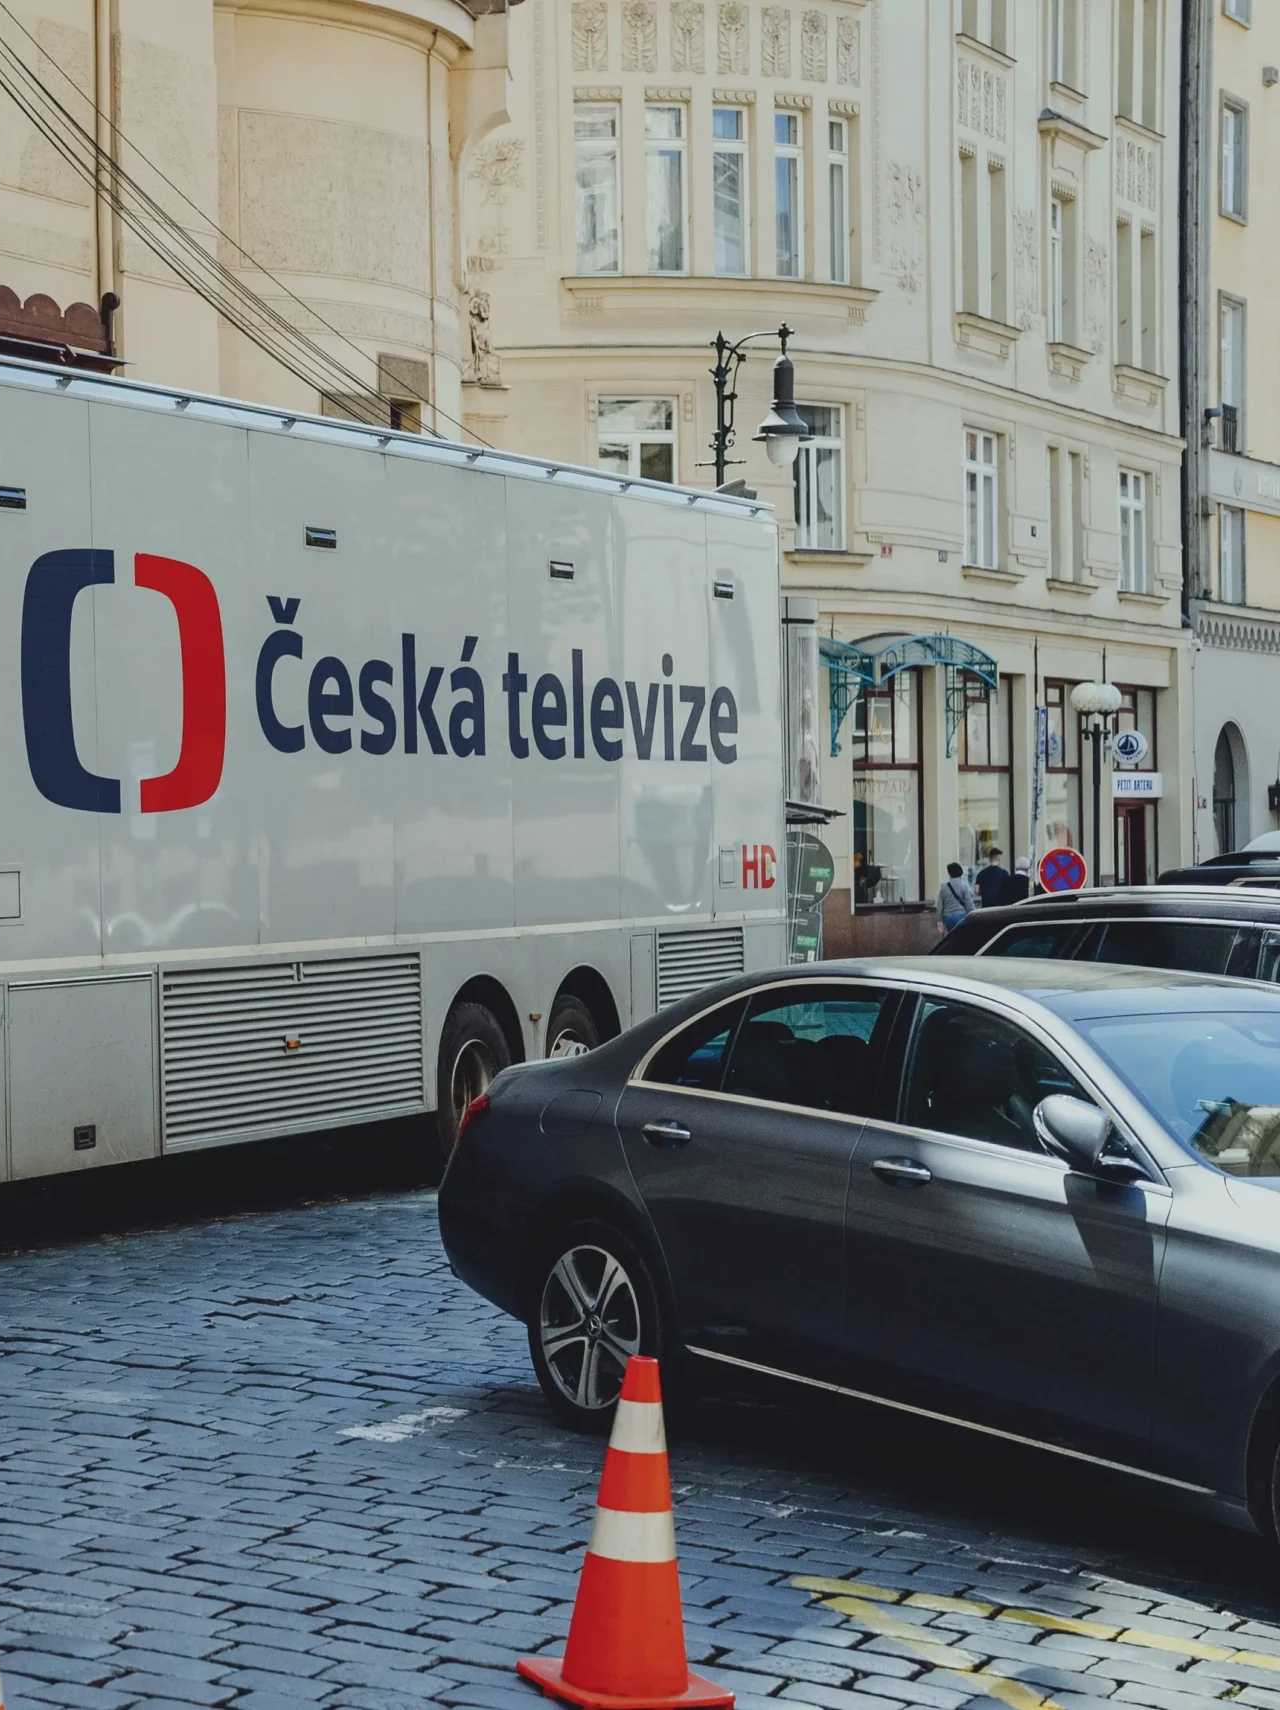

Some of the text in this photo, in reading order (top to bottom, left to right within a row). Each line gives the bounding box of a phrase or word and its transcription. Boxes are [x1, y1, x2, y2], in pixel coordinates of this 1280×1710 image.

[255, 595, 739, 764] Česká televize
[742, 844, 777, 889] HD
